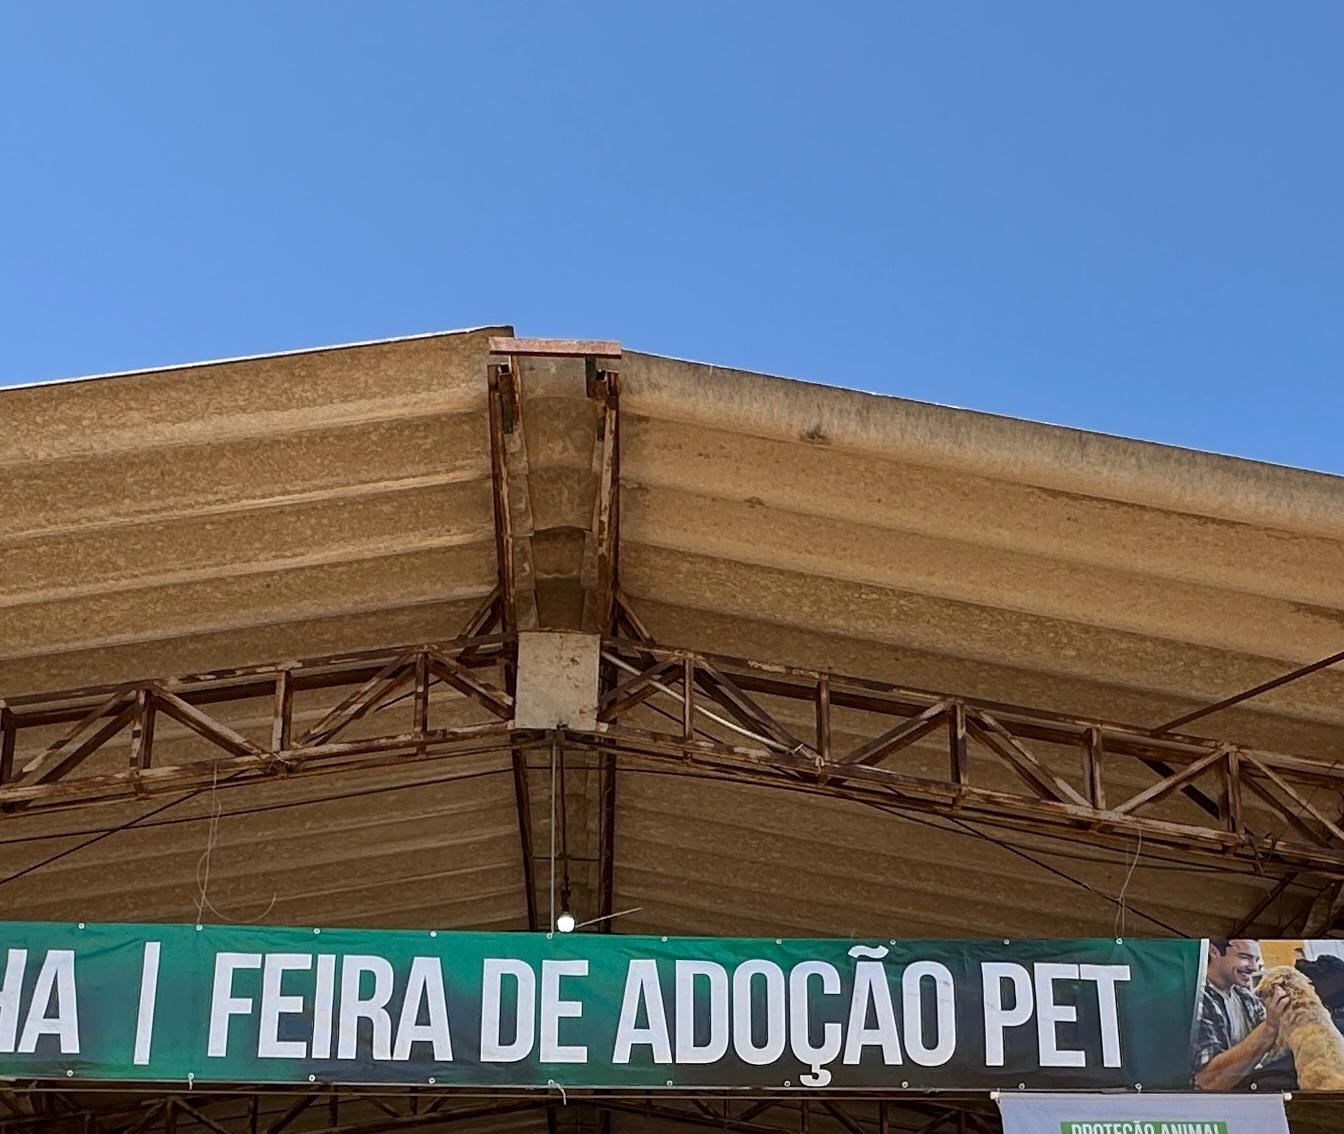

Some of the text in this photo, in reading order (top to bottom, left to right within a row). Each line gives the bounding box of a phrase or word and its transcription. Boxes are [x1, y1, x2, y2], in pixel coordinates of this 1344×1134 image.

[207, 952, 454, 1061] FEIRA
[480, 958, 588, 1063] DE
[612, 945, 956, 1087] ADOÇÃO
[981, 962, 1131, 1068] PET
